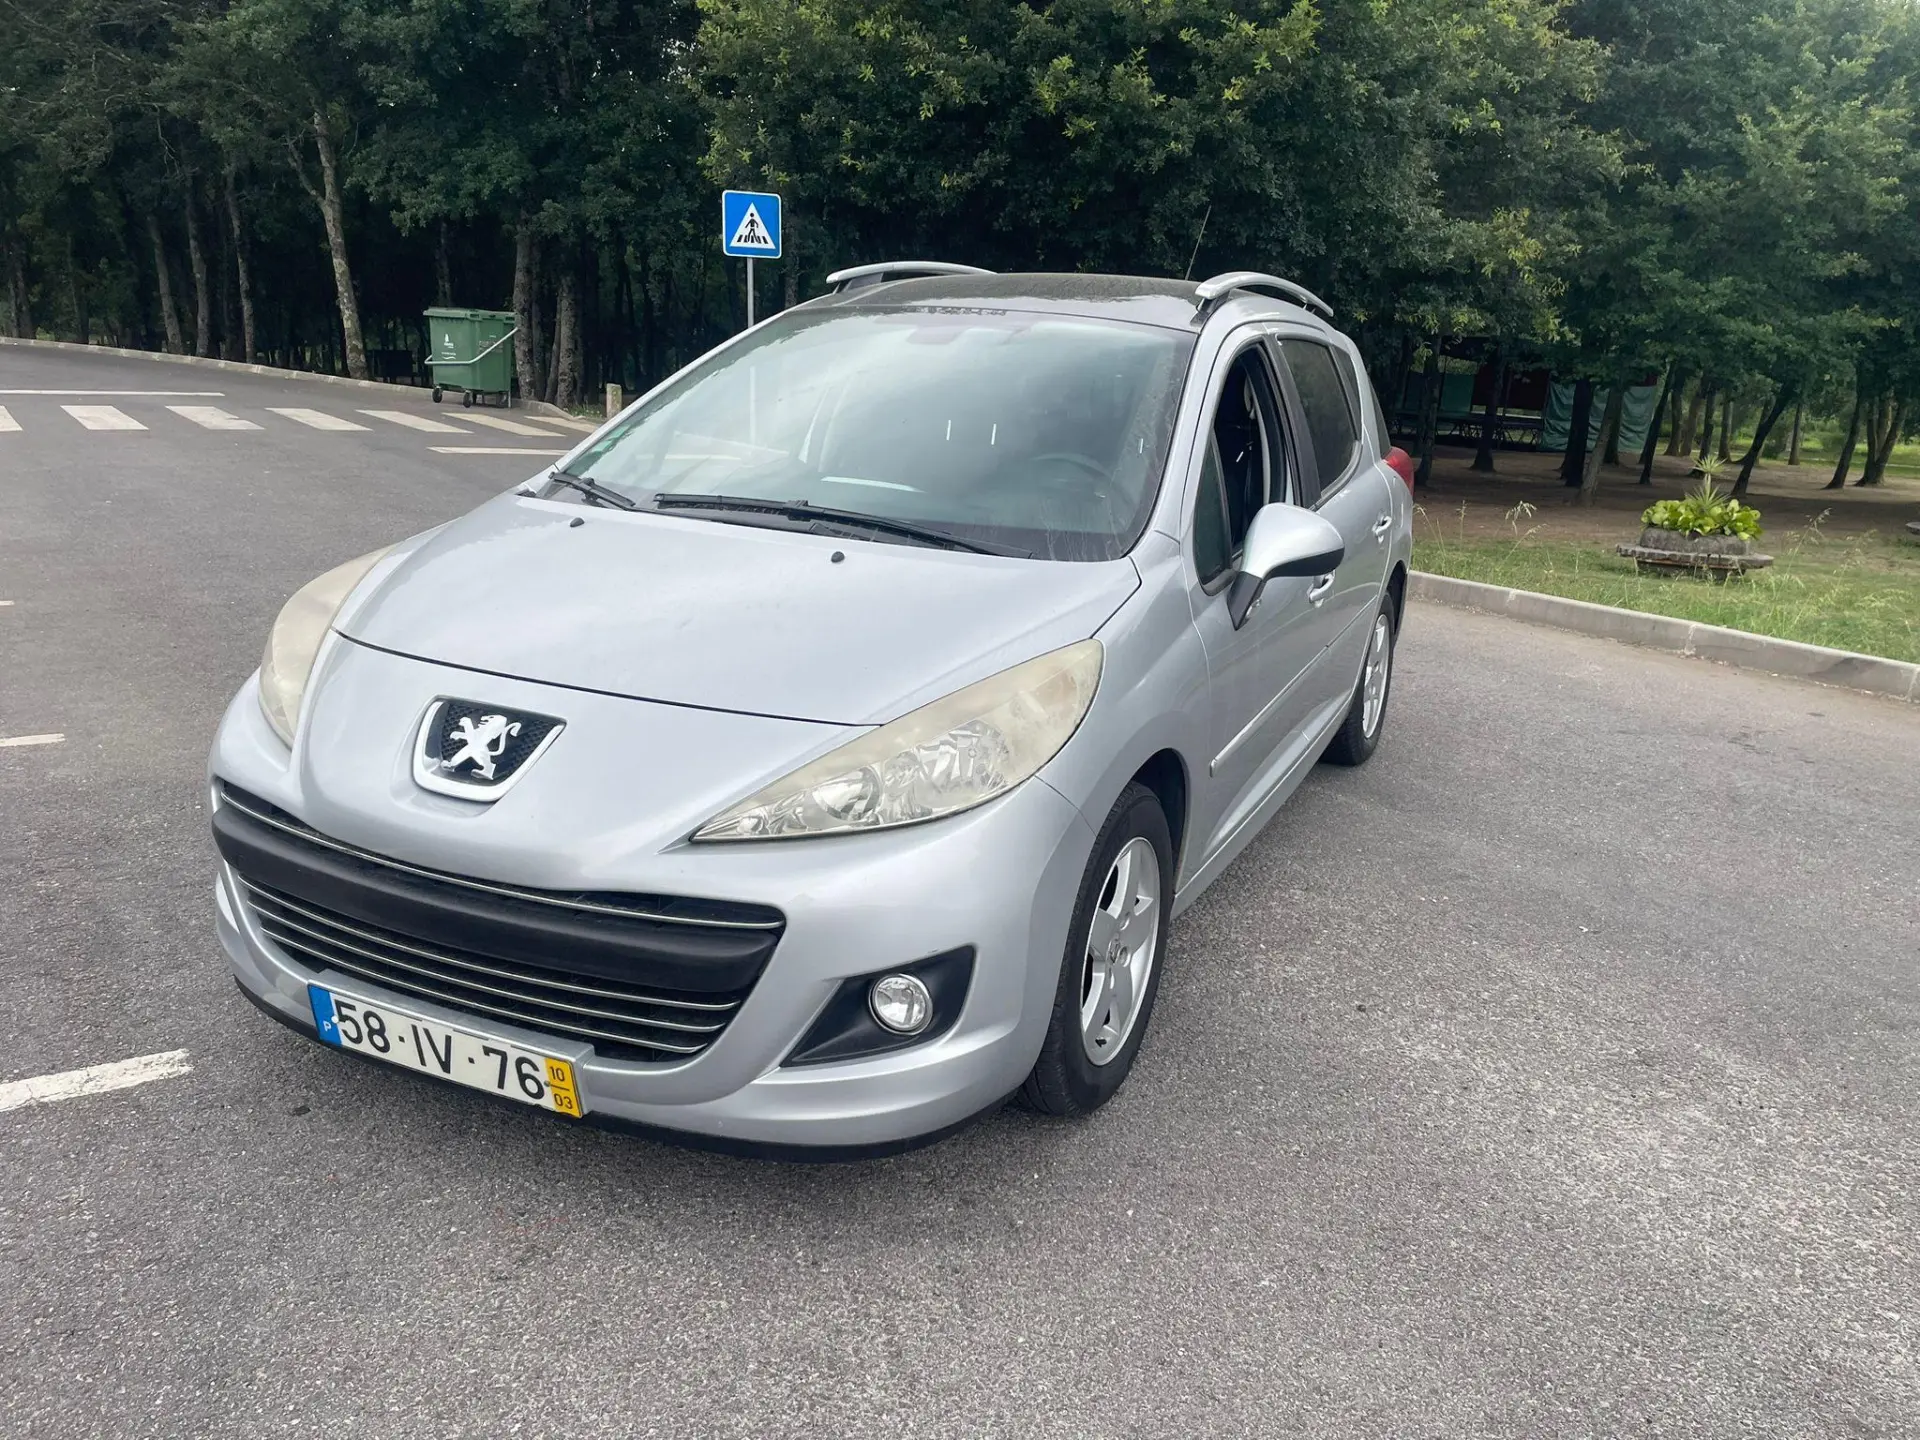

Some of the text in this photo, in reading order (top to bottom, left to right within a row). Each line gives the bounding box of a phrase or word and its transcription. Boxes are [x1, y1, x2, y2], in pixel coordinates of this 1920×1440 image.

[323, 1020, 332, 1032] P
[550, 1066, 565, 1081] 10
[554, 1093, 573, 1109] 03
